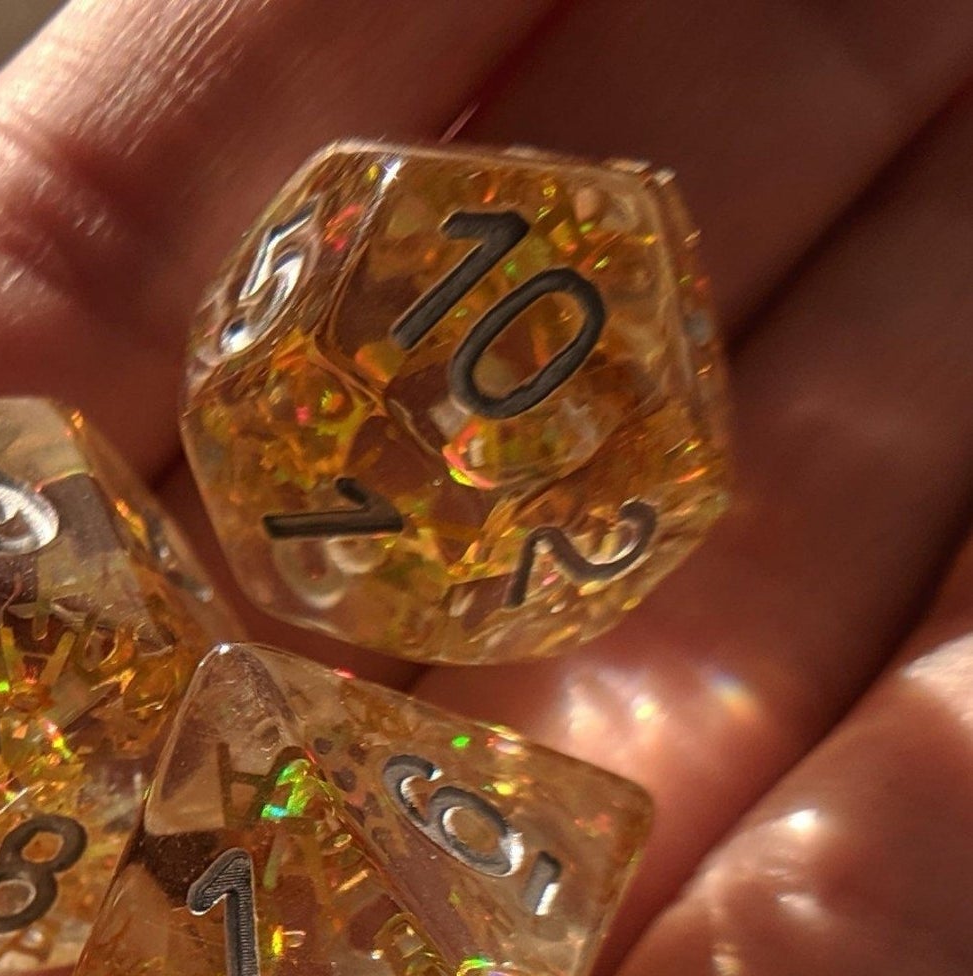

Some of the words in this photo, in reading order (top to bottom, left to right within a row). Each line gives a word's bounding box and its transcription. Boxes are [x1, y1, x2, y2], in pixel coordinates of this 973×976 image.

[390, 210, 606, 419] 10
[262, 477, 404, 538] 1
[503, 499, 659, 609] 2
